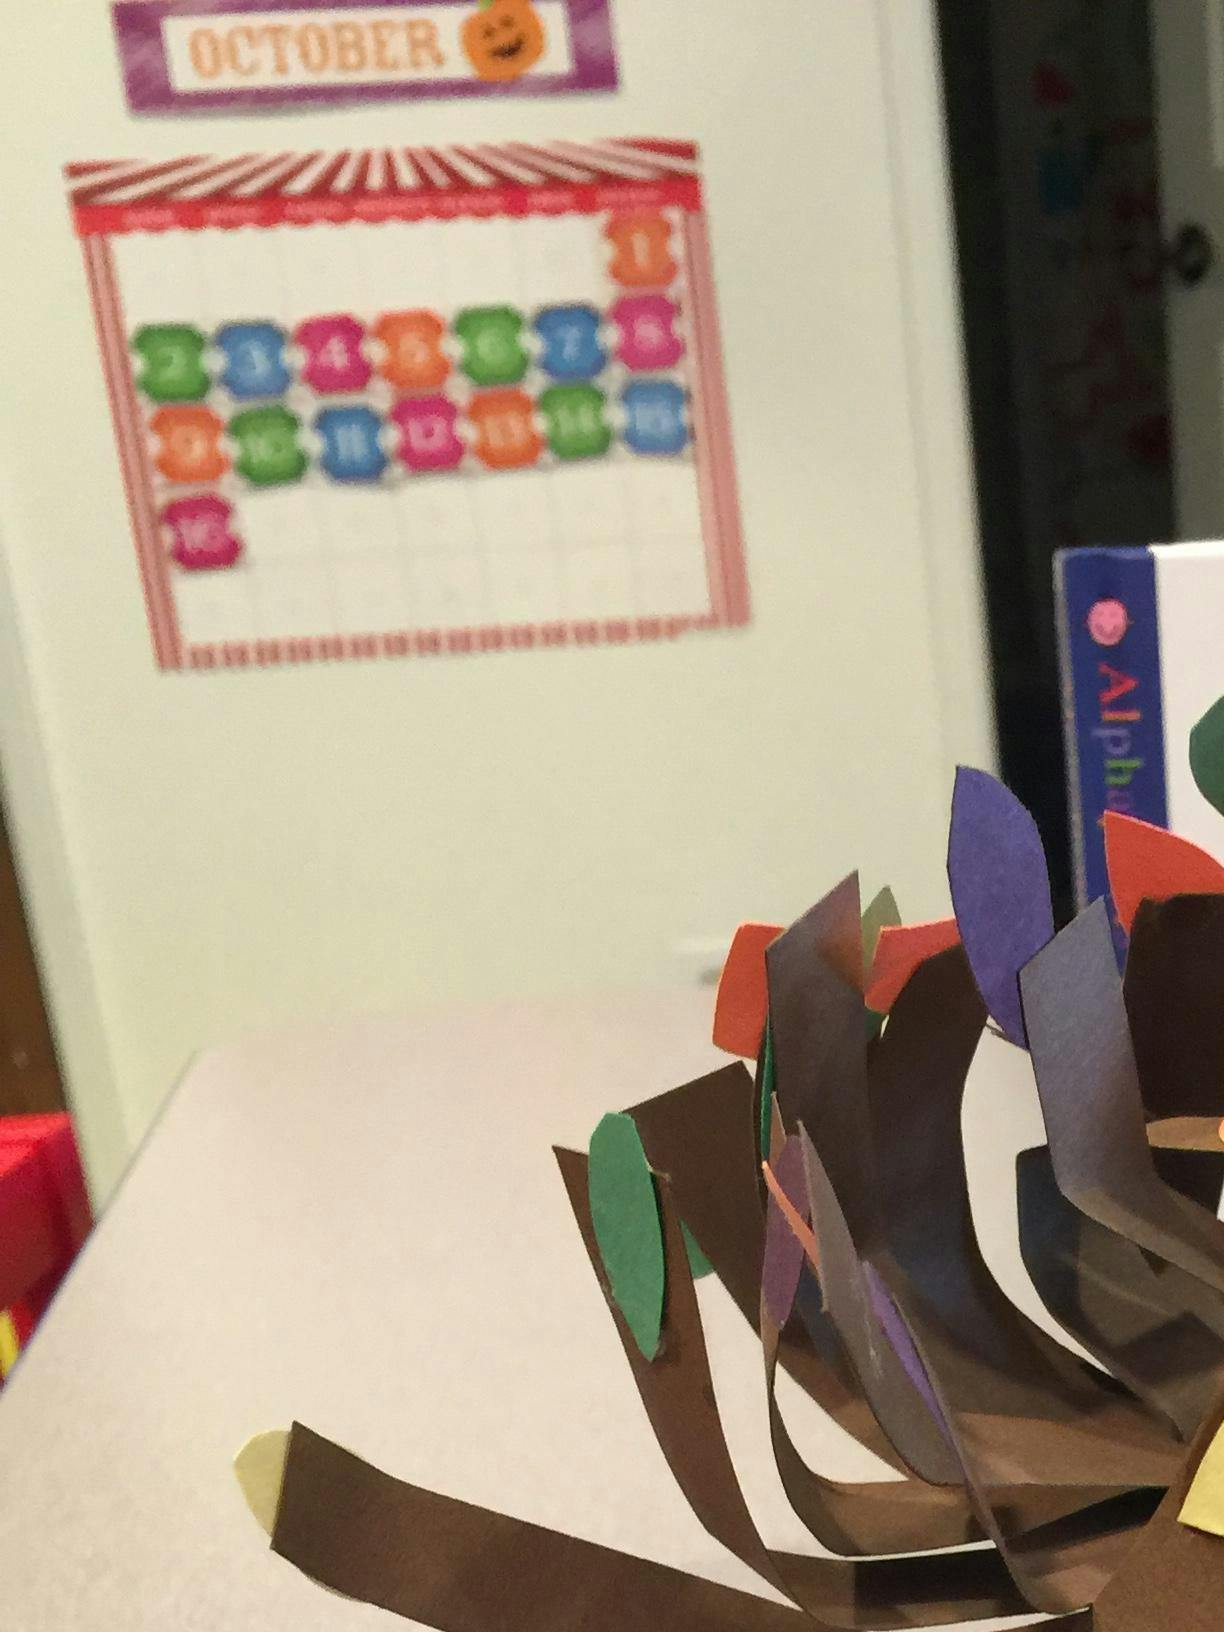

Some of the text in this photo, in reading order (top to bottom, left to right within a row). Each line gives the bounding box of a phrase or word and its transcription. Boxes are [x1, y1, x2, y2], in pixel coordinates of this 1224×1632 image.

[188, 19, 444, 79] OCTOBER
[156, 344, 188, 380] 2
[318, 336, 348, 371] 4
[1090, 660, 1143, 826] Alpha
